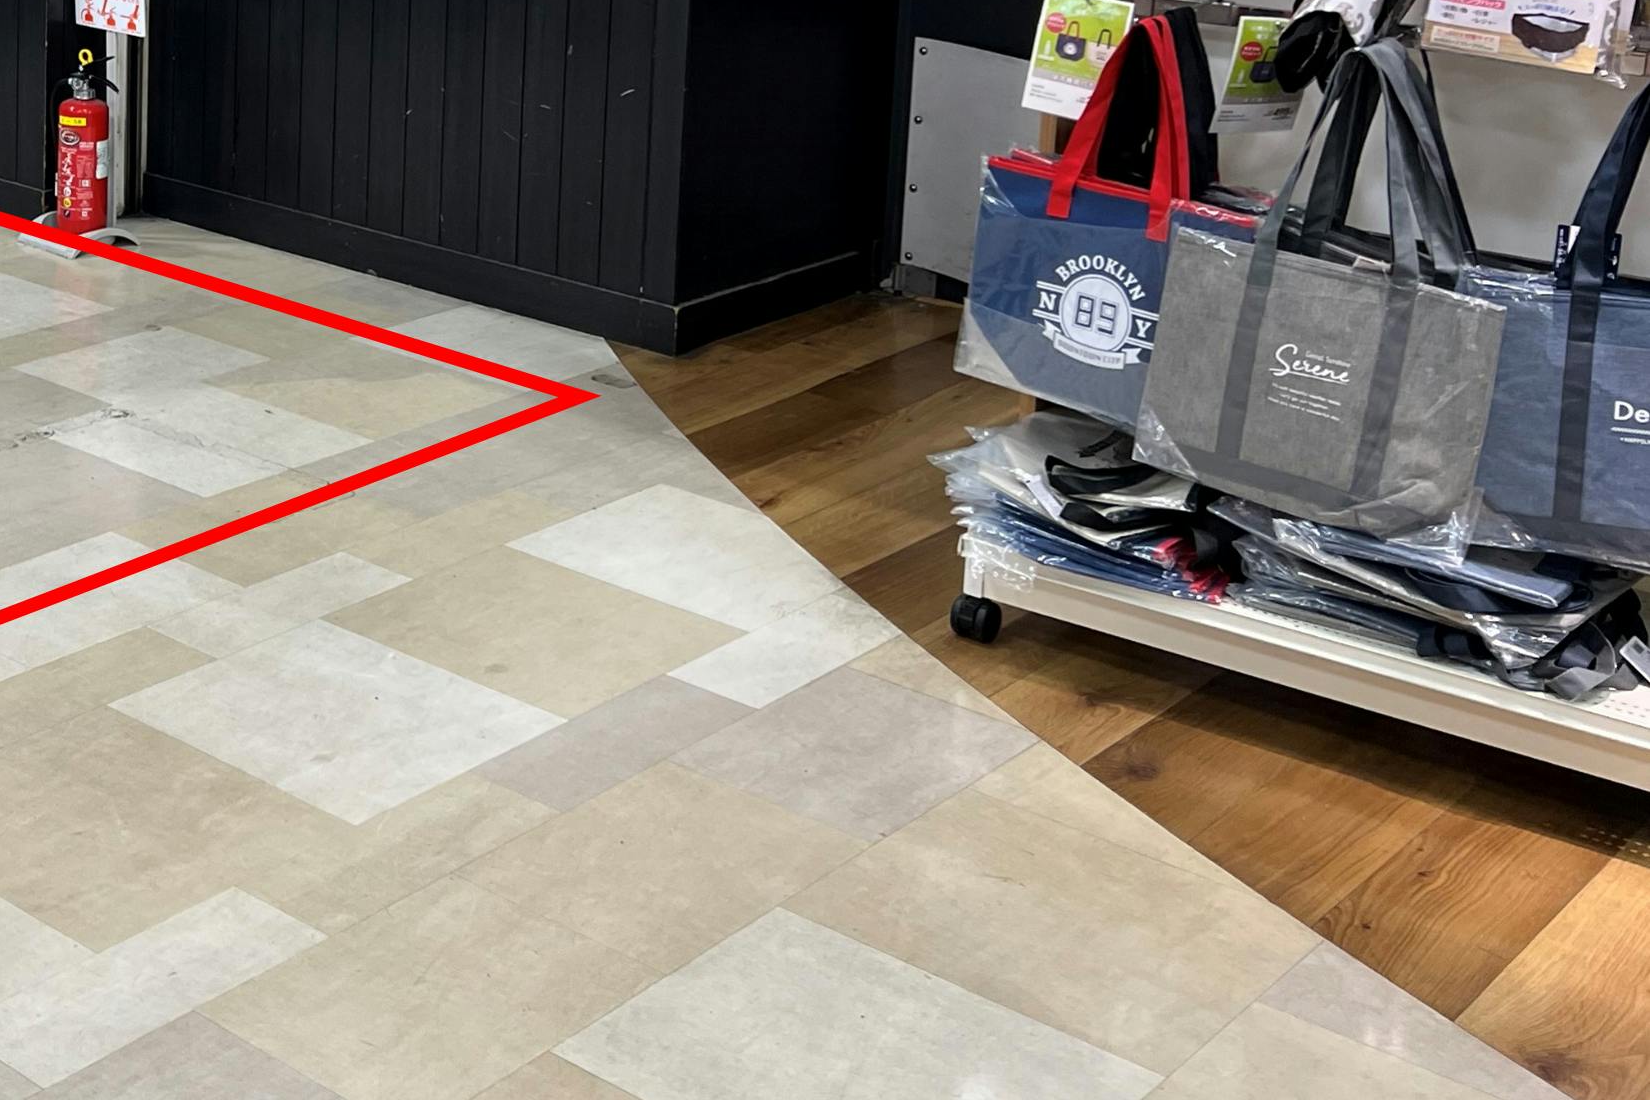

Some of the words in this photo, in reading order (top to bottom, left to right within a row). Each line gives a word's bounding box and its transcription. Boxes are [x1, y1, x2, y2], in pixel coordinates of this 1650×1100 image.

[1055, 255, 1146, 301] BROOKLYN
[1038, 291, 1057, 310] N
[1074, 294, 1118, 336] 89
[1135, 319, 1152, 338] Y
[1271, 343, 1350, 383] Serene
[1613, 400, 1650, 423] De
